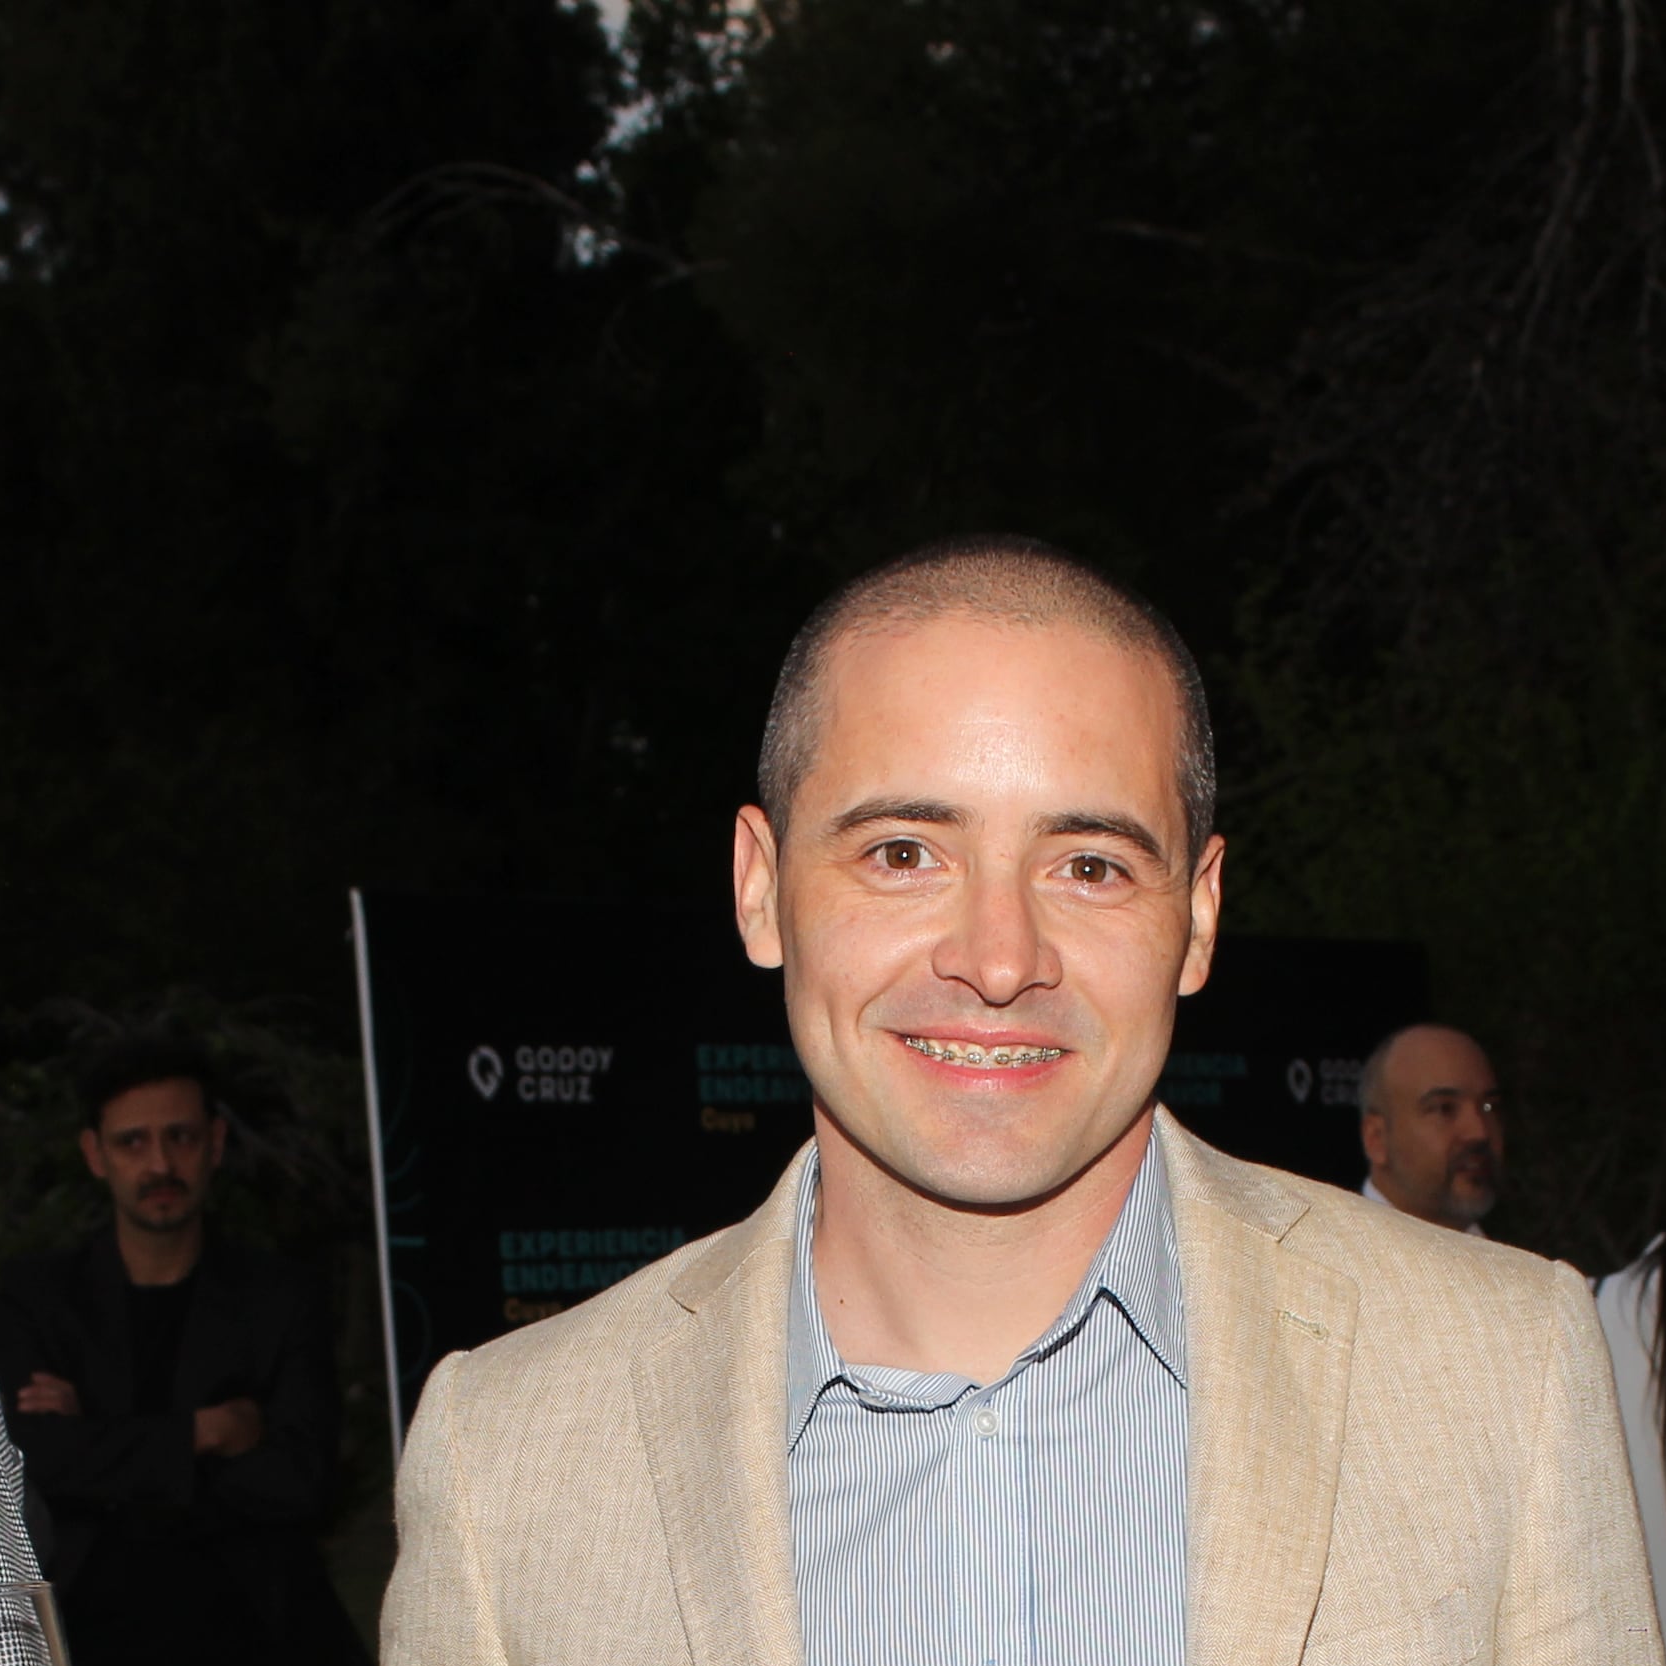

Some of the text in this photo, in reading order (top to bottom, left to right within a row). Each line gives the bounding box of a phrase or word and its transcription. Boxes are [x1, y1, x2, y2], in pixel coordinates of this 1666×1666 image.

[515, 1046, 614, 1072] GODOY
[517, 1076, 594, 1102] CRUZ
[500, 1228, 685, 1259] EXPERIENCIA
